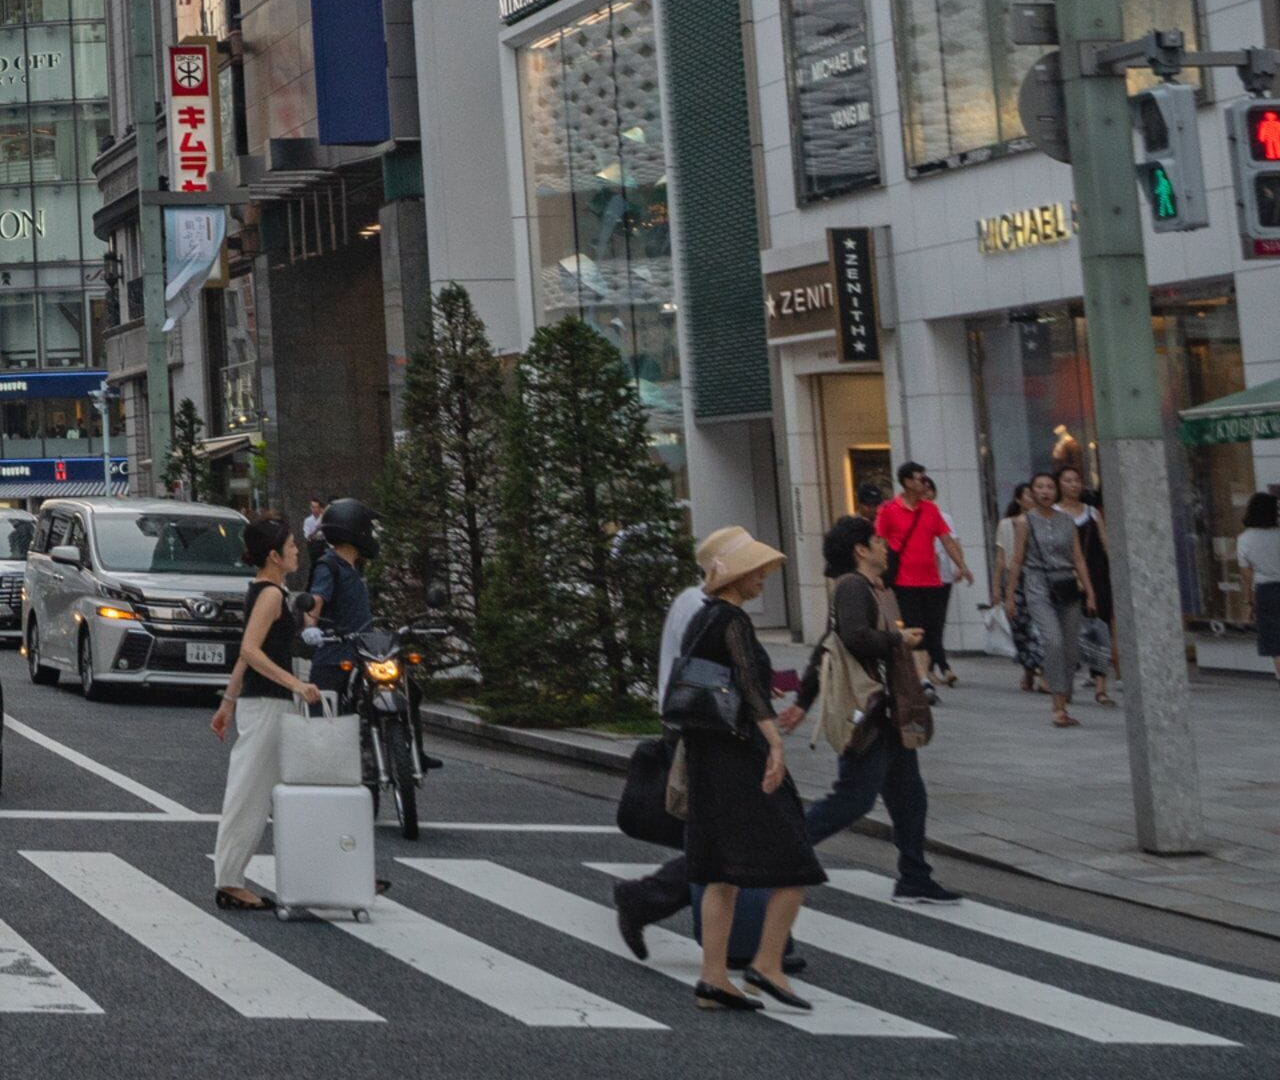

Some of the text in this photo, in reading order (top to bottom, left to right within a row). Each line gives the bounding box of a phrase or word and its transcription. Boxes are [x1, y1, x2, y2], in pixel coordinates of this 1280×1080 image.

[14, 52, 62, 73] OFF
[976, 203, 1071, 256] MICHAEL
[779, 282, 837, 316] ZENIT
[845, 253, 867, 338] ZENITH
